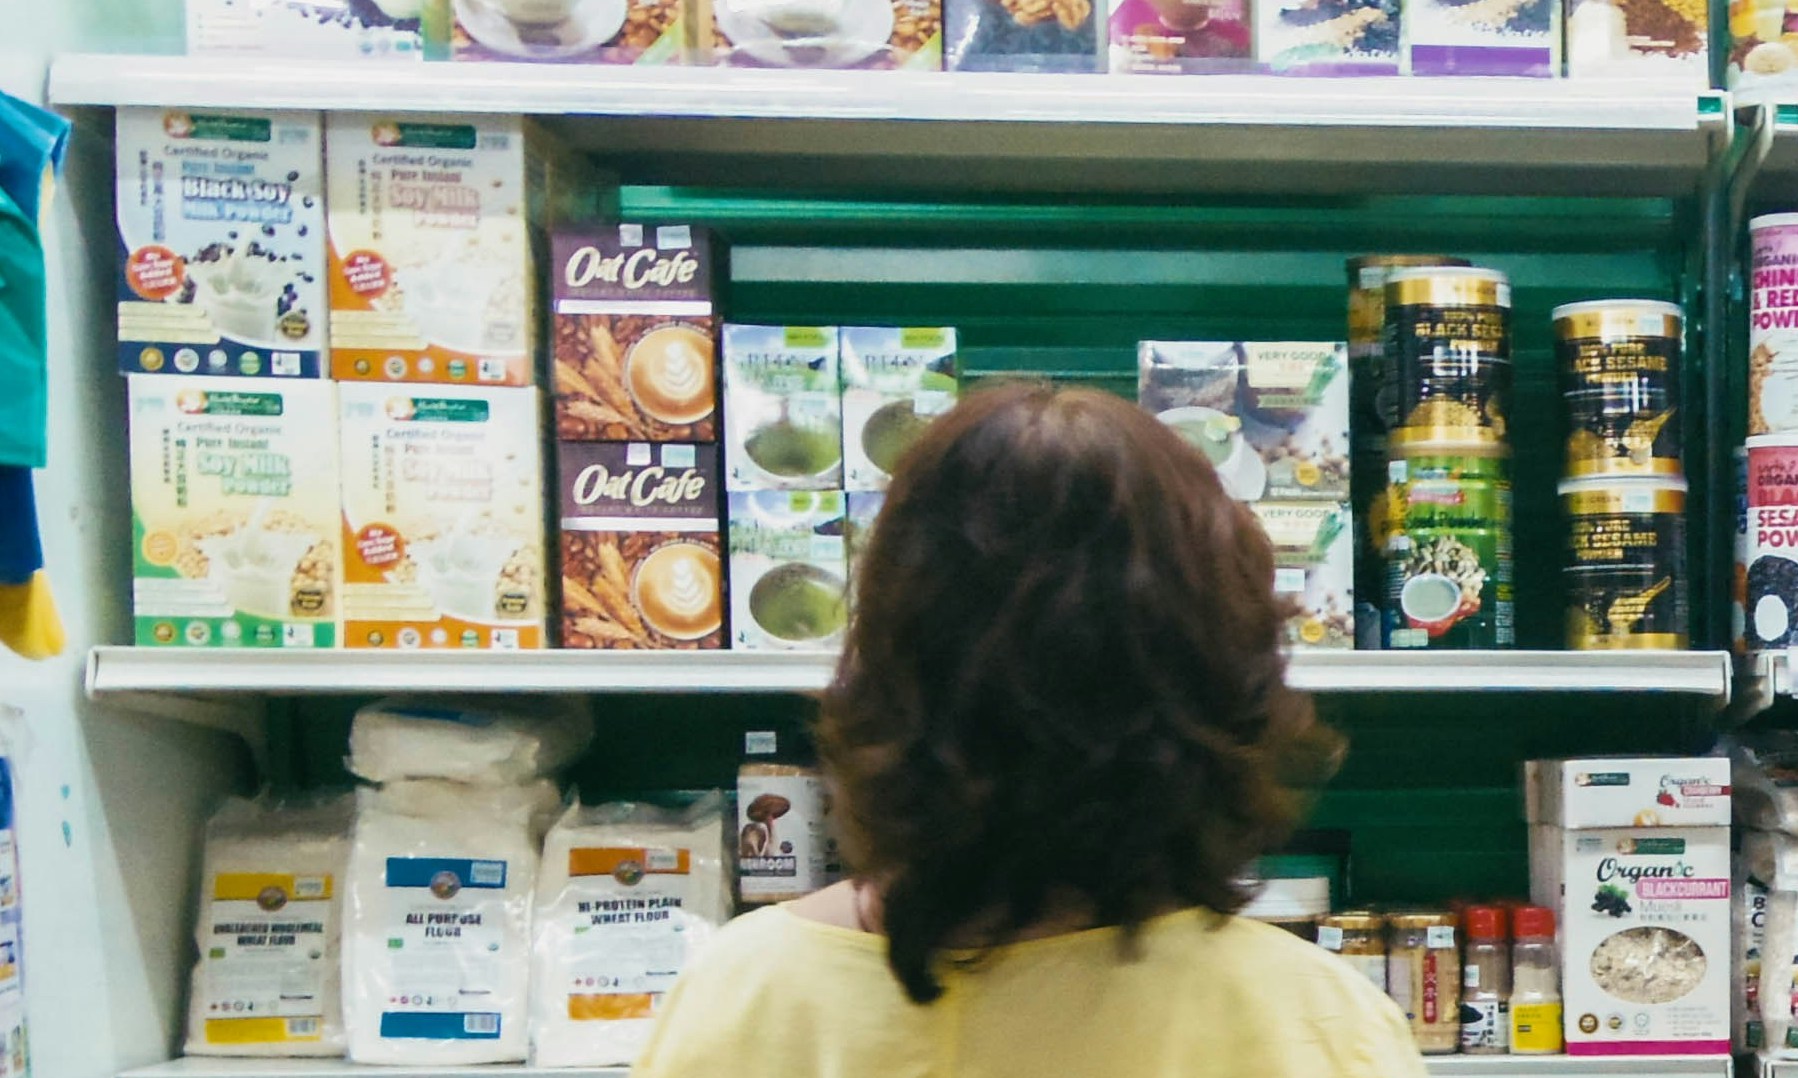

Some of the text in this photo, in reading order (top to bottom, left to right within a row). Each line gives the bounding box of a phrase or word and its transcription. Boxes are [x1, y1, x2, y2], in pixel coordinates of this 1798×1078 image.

[181, 175, 292, 205] Black Soy
[564, 246, 698, 290] Oat Cafe
[1415, 322, 1468, 338] BLACK
[573, 464, 706, 507] Oat Cafe
[406, 913, 425, 926] ALL
